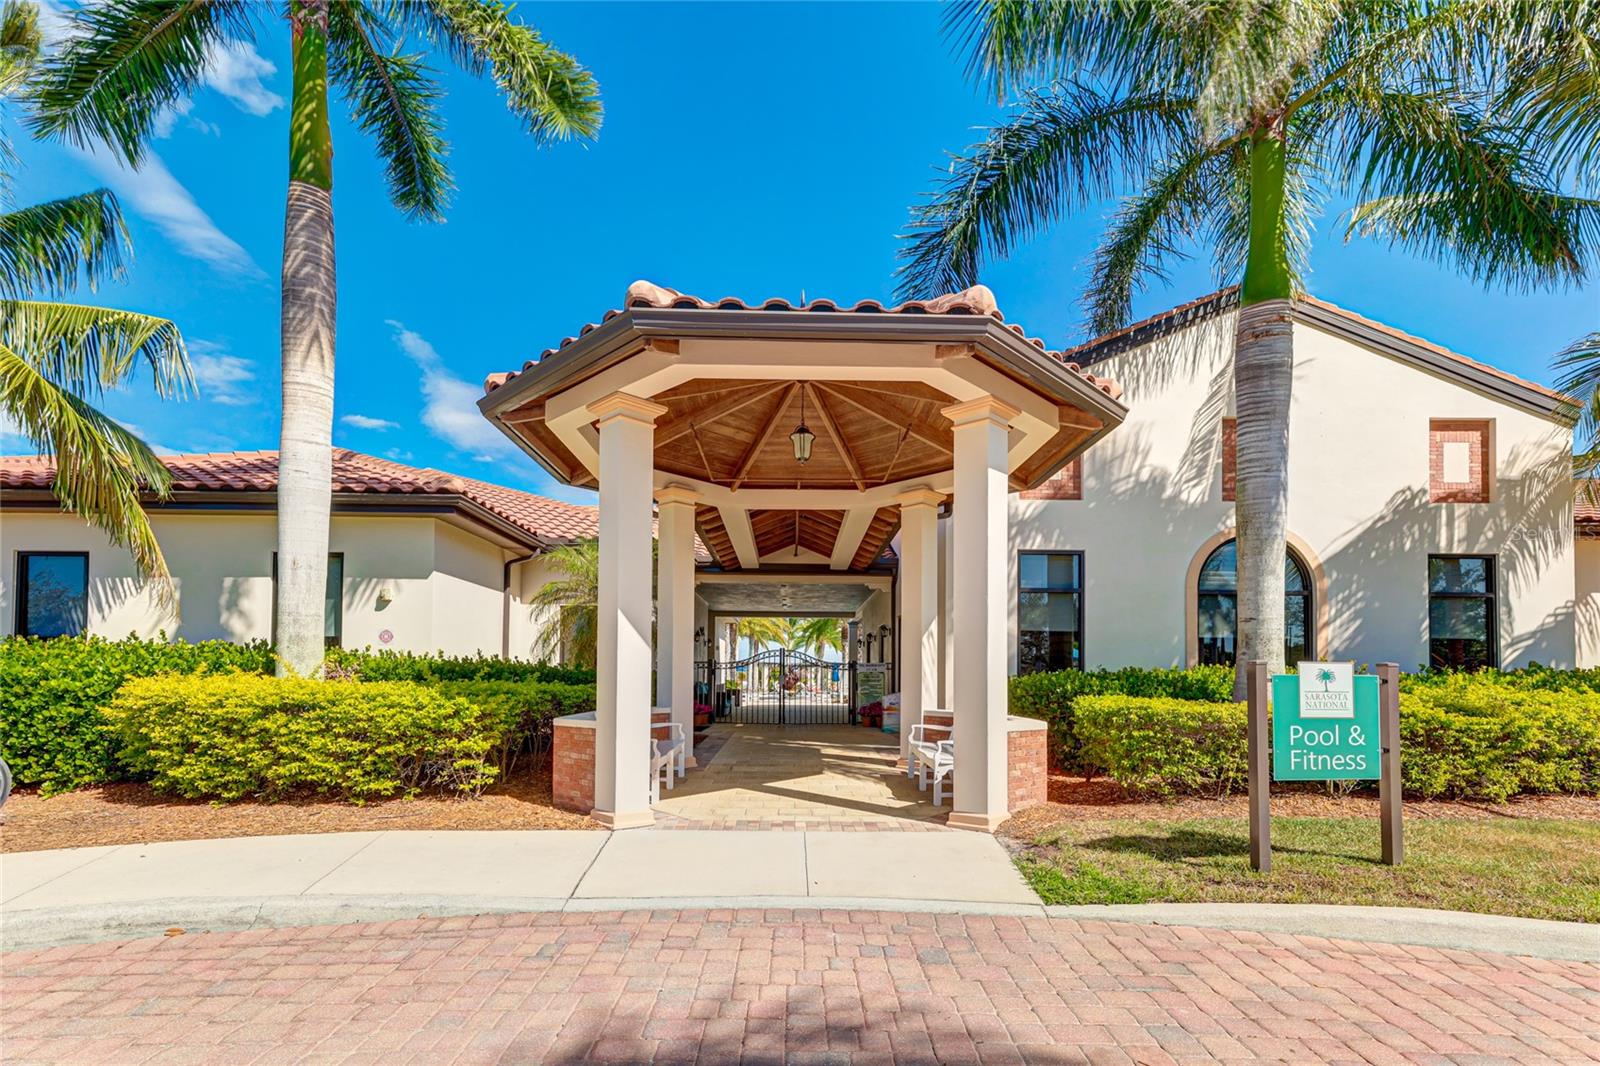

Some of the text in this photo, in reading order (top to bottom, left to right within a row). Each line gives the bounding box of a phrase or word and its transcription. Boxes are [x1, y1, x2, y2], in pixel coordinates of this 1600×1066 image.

[1304, 693, 1349, 701] SARASOTA
[1304, 701, 1348, 709] NATIONAL
[1289, 724, 1367, 746] Pool &
[1290, 750, 1367, 771] Fitness
